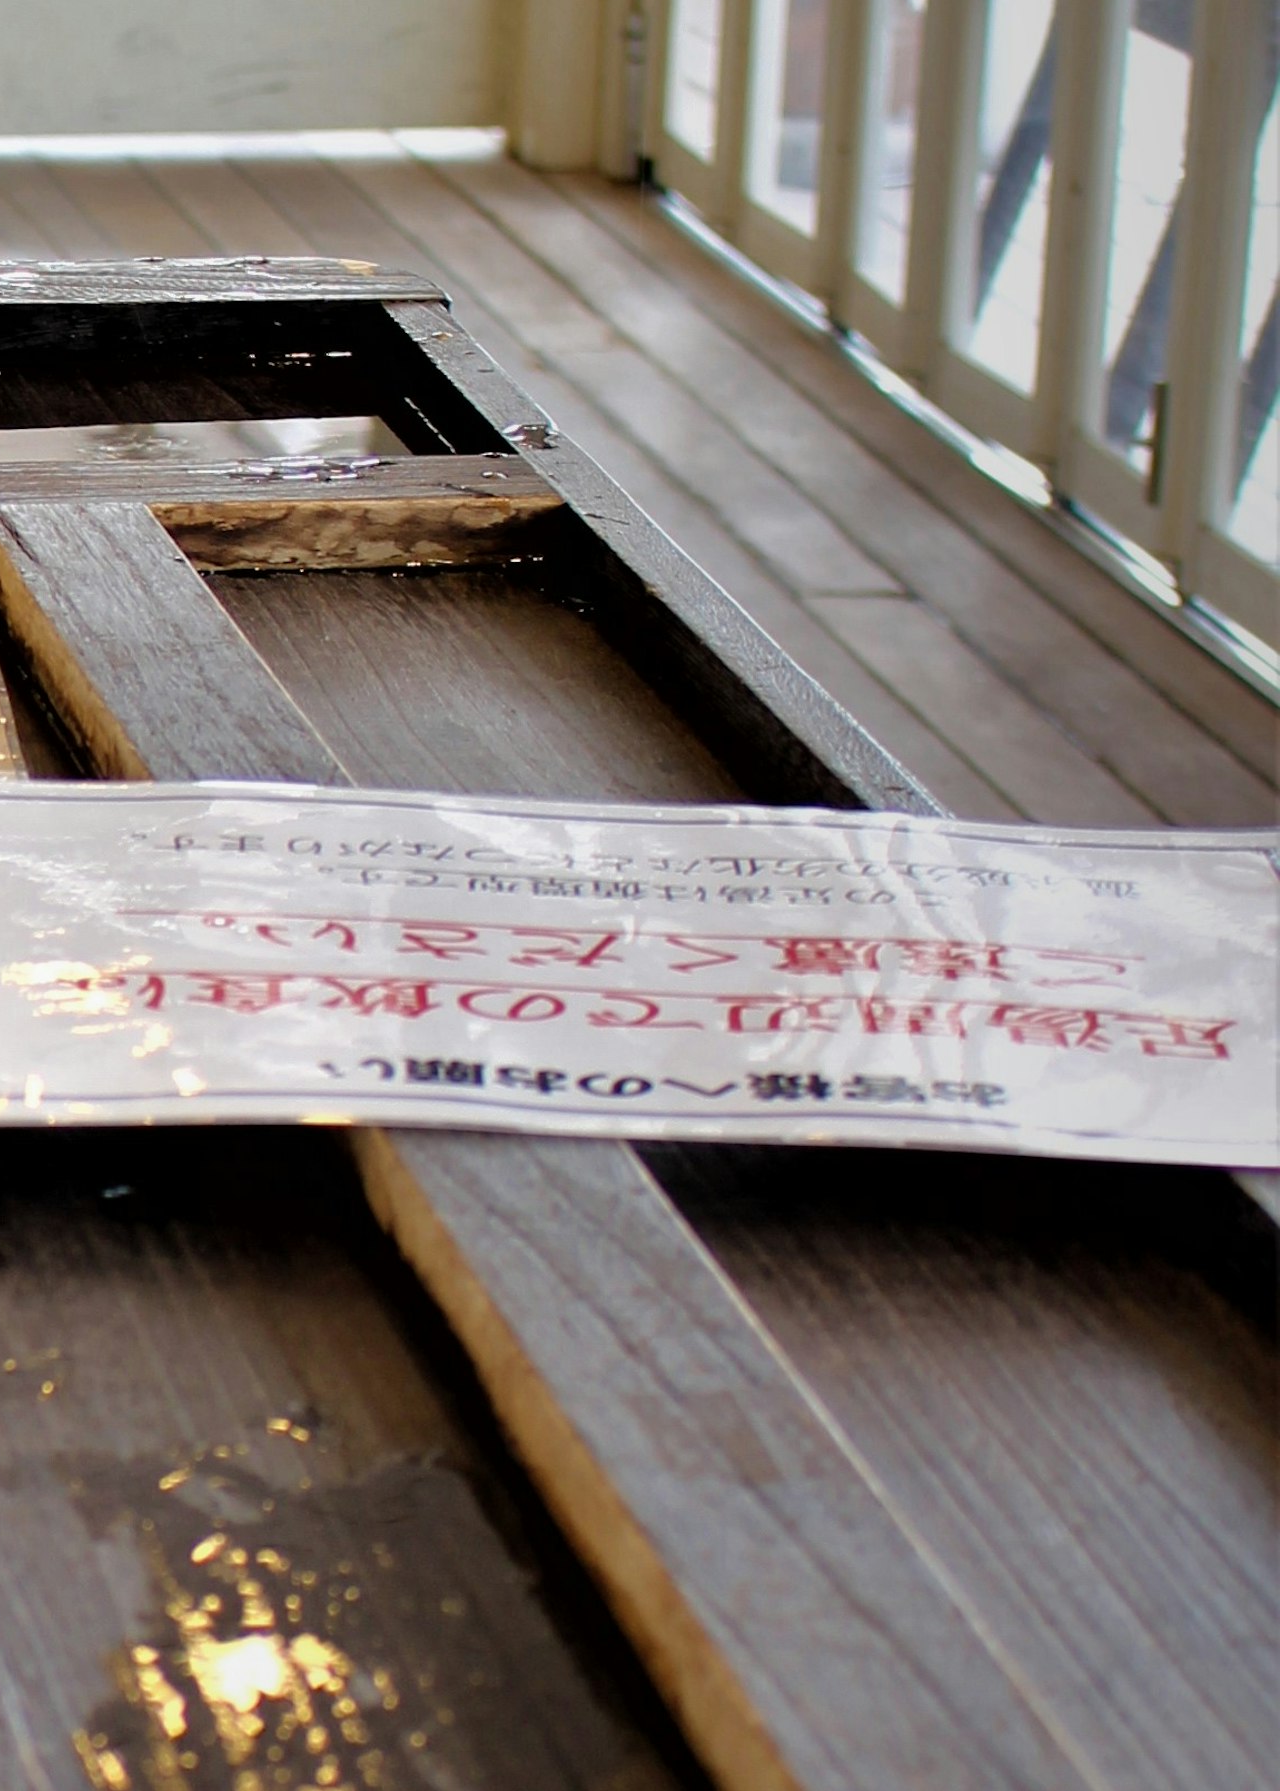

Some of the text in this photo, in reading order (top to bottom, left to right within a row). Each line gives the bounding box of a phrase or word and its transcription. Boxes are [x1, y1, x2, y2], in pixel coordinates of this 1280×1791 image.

[131, 832, 1141, 899] 温成分の劣化などにつながります。
[318, 866, 956, 907] この足湯は循環型です。
[201, 915, 1130, 989] ご遠慮ください。
[57, 972, 1237, 1060] 足湯周辺での飲食は
[318, 1057, 1008, 1107] お客様へのお願い
